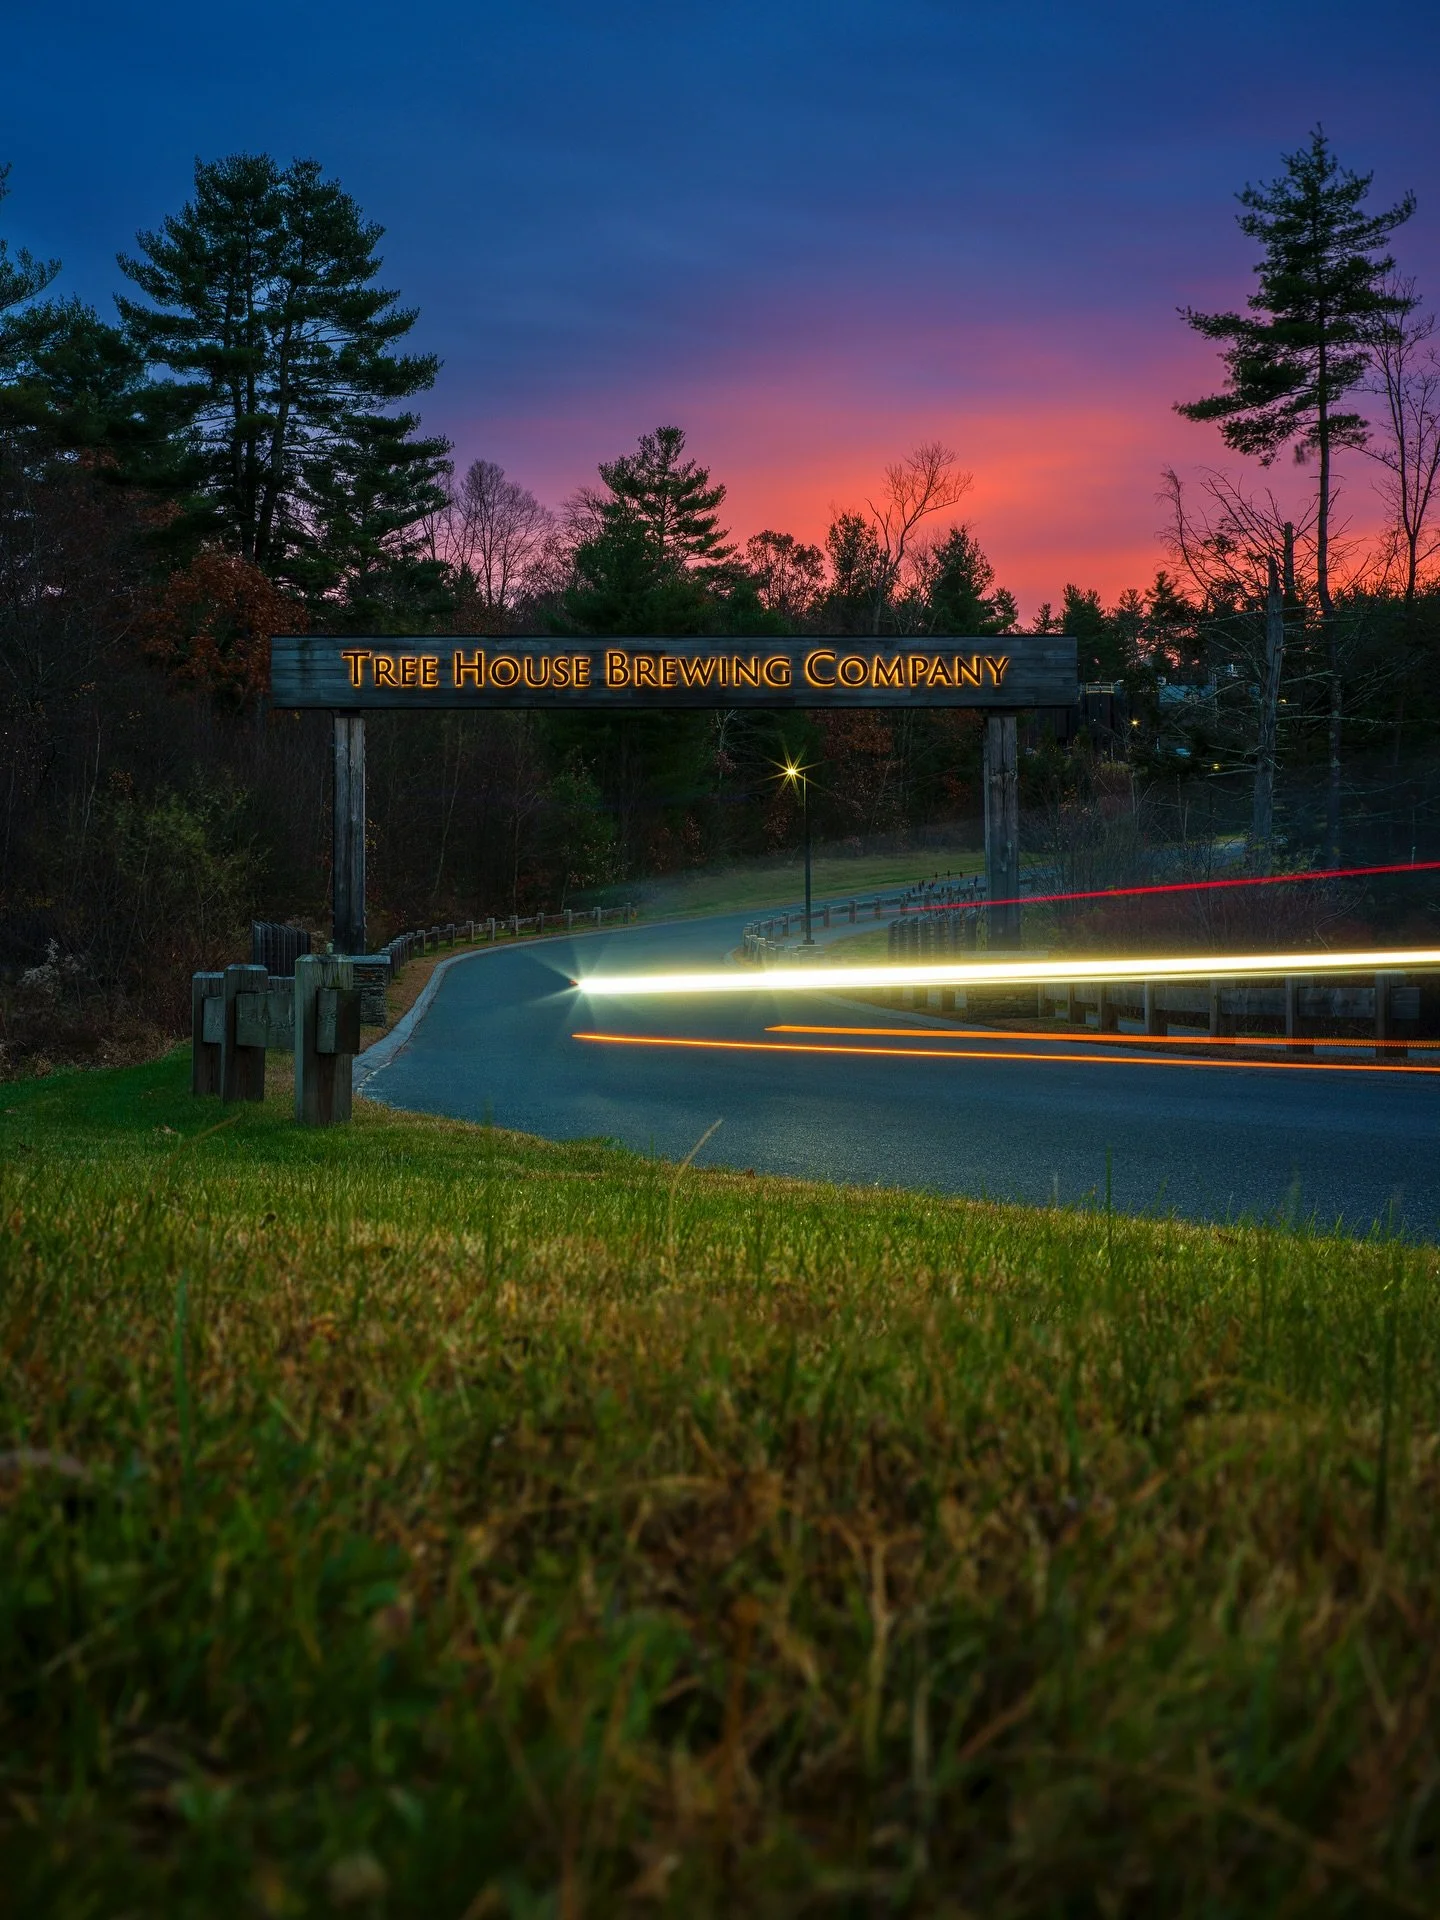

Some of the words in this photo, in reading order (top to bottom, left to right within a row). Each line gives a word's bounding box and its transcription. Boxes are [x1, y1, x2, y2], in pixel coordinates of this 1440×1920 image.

[342, 650, 438, 687] TREE
[454, 650, 590, 687] HOUSE
[606, 650, 791, 688] BREWING
[805, 650, 1010, 688] COMPANY
